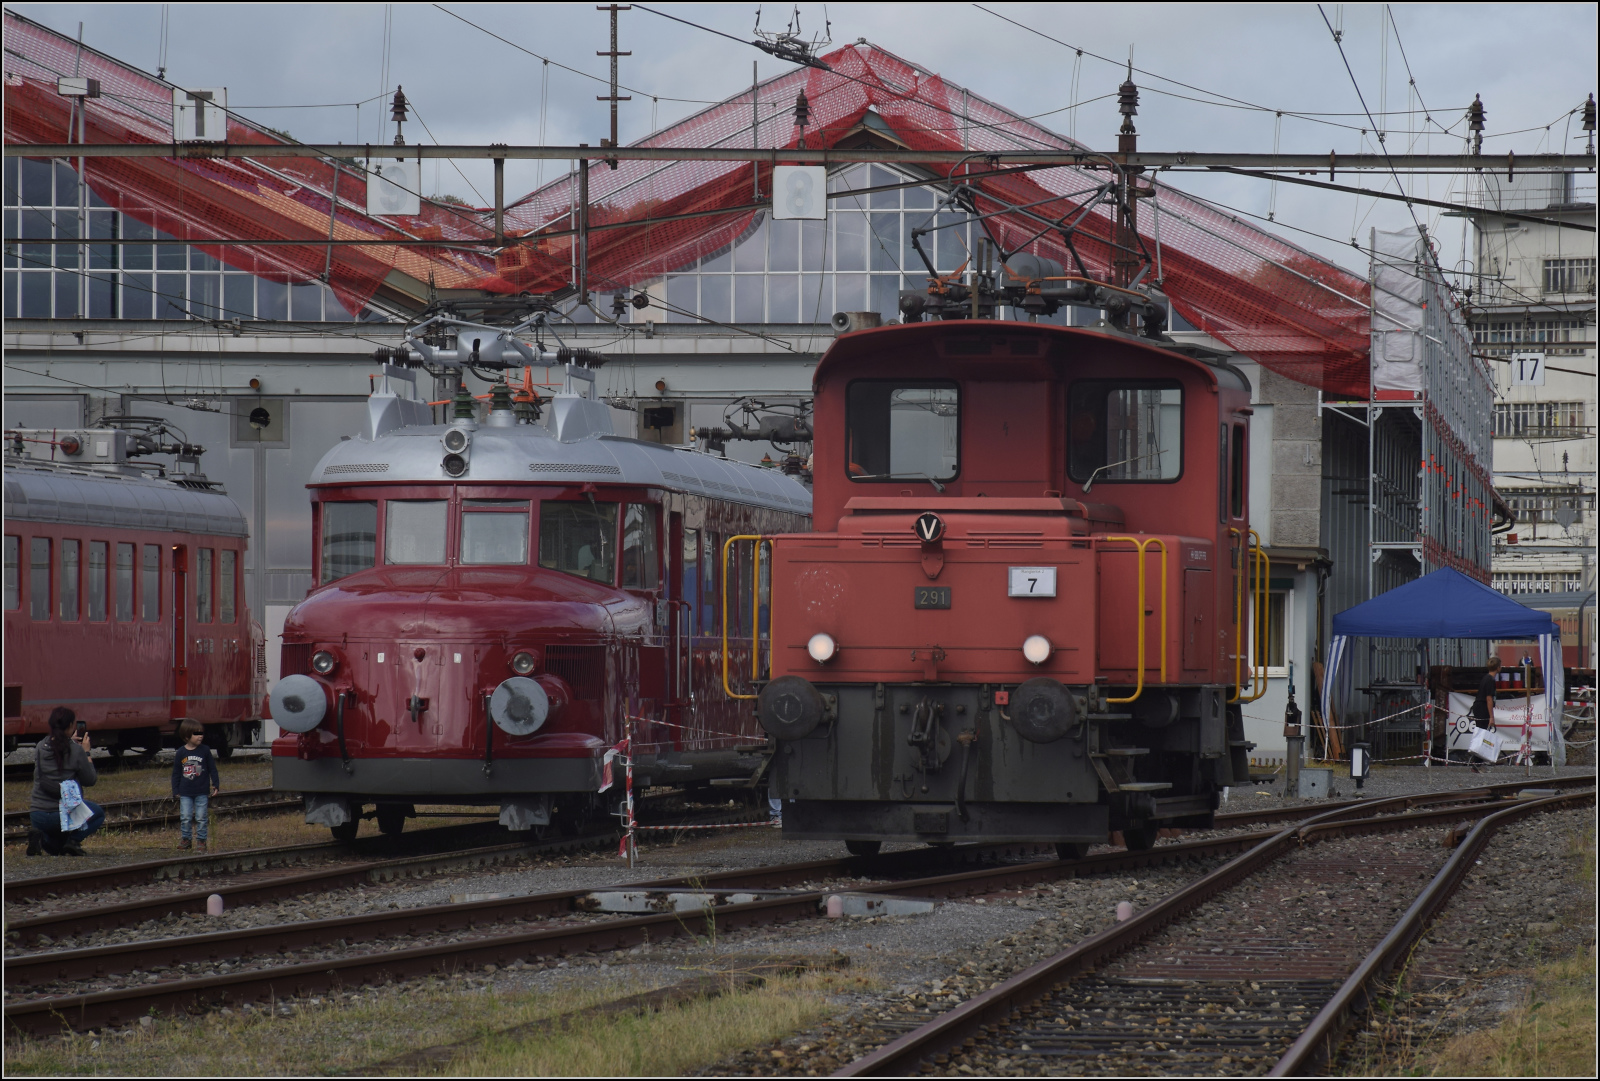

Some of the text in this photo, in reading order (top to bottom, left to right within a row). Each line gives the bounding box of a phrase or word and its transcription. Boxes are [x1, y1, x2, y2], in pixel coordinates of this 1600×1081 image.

[186, 91, 213, 137] T
[380, 166, 408, 212] 9
[786, 170, 814, 217] 8
[1517, 358, 1539, 381] T7
[920, 518, 938, 540] V
[1027, 578, 1038, 593] 7
[920, 590, 946, 605] 291
